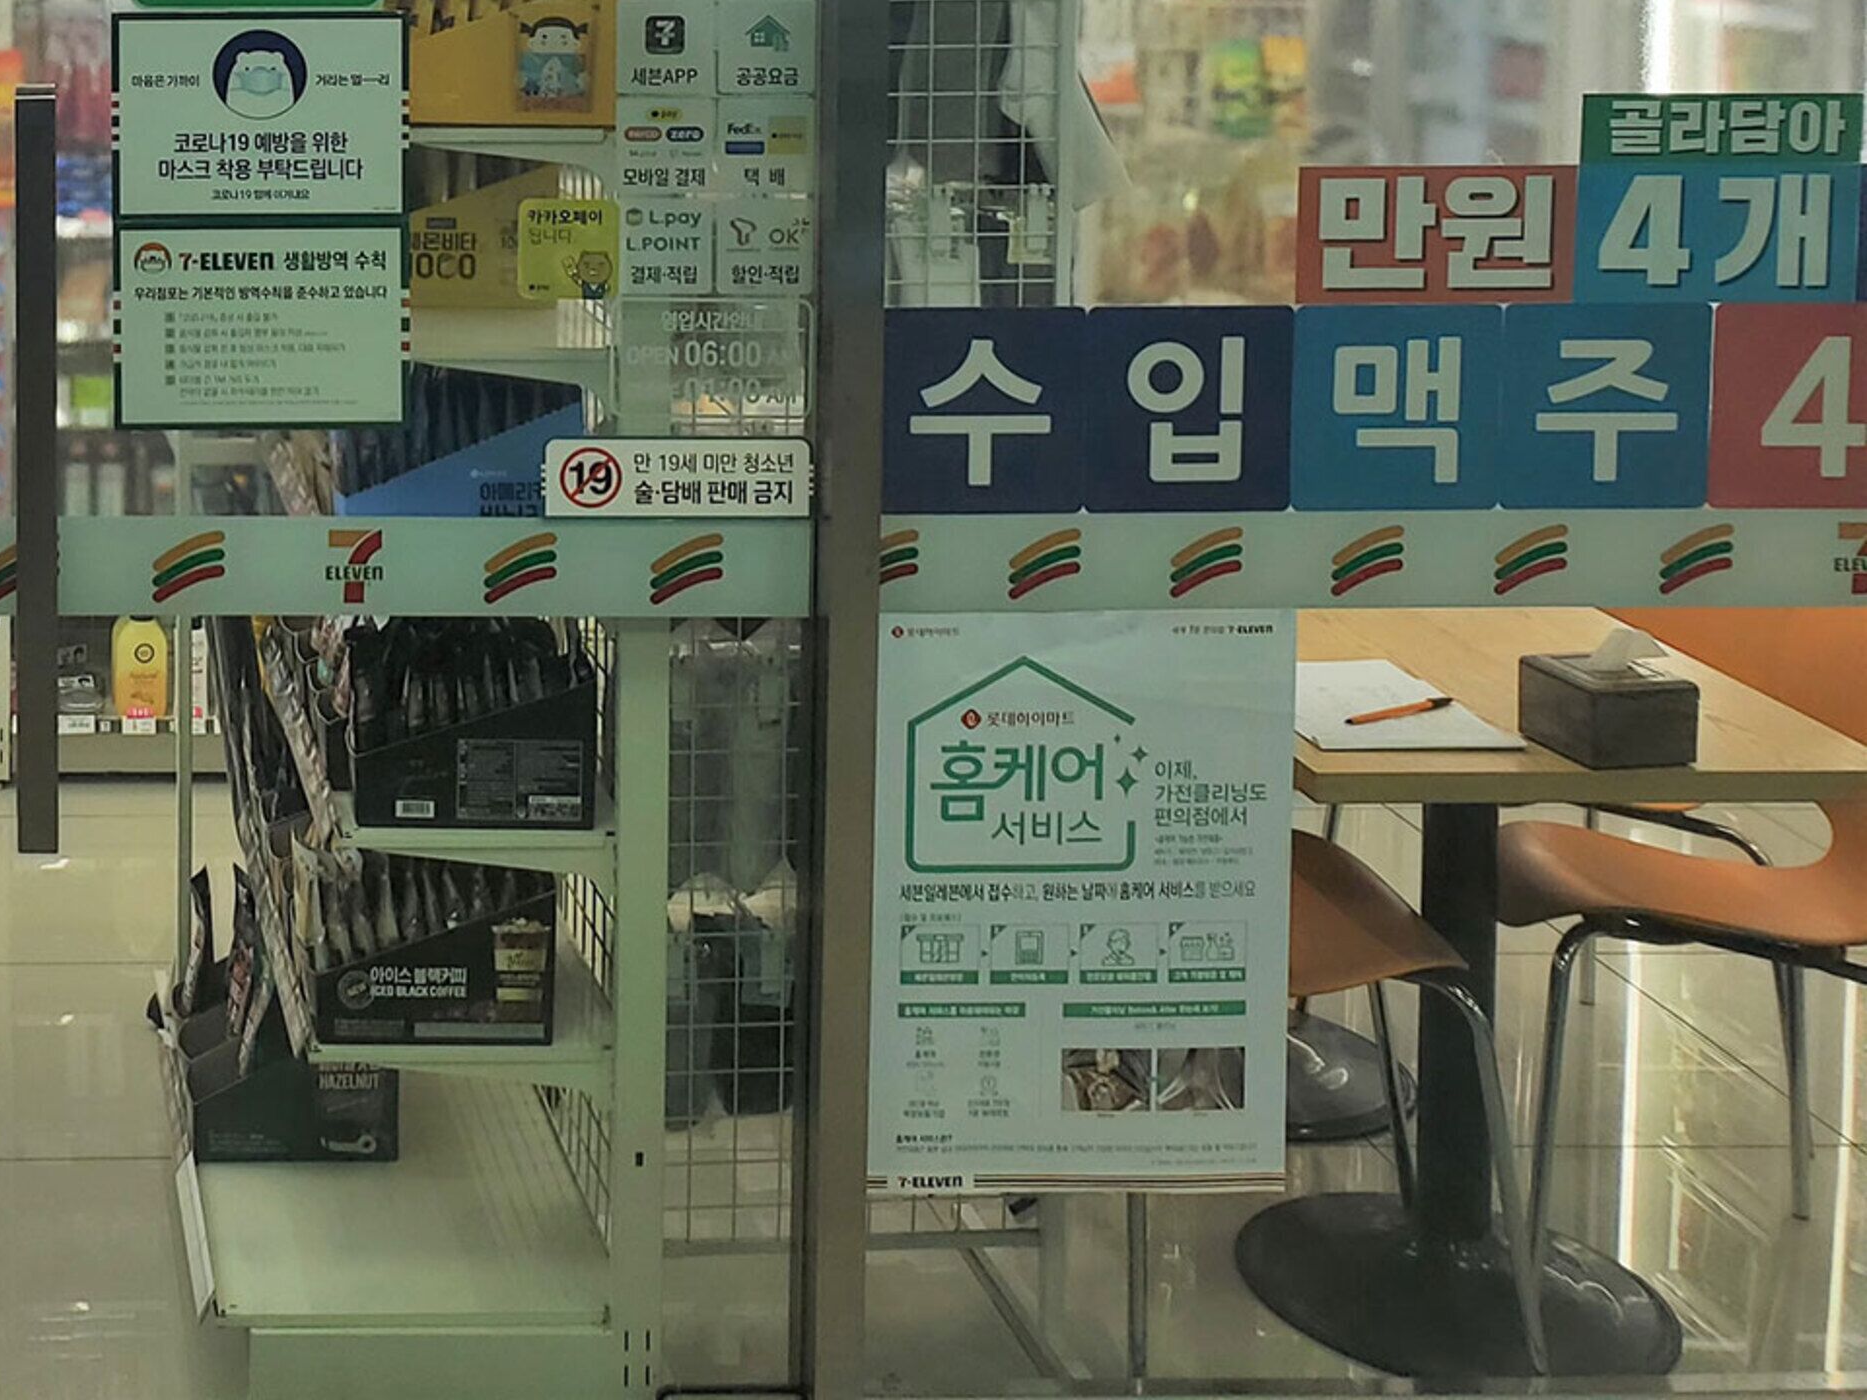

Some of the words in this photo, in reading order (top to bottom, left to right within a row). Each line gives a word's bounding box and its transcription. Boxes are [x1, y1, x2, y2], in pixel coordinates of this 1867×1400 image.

[631, 67, 699, 87] 세븐APP
[736, 66, 800, 87] 공공요금
[1608, 99, 1847, 156] 골라담아
[174, 132, 250, 154] 코로나19
[254, 131, 307, 154] 예방을
[311, 131, 348, 154] 위한
[158, 158, 212, 181] 마스크
[216, 158, 252, 180] 착용
[256, 157, 364, 181] 부탁드립니다
[622, 167, 670, 187] 모바일
[675, 167, 706, 187] 결제
[527, 209, 603, 225] 카카오페이
[649, 210, 702, 228] L.pay
[625, 236, 702, 251] L.POINT
[1318, 174, 1555, 292] 만원
[283, 250, 349, 272] 생활방역
[354, 250, 388, 272] 수칙
[684, 340, 761, 367] 06:00
[633, 453, 652, 473] 만
[659, 453, 697, 472] 19세
[702, 453, 738, 472] 미만
[742, 452, 794, 472] 청소년
[707, 480, 748, 504] 판매
[754, 480, 794, 504] 금지
[930, 740, 1104, 821] 홈케어
[1154, 760, 1198, 781] 이제,
[1154, 783, 1268, 804] 가전클리닝도
[1154, 806, 1249, 827] 편의점에서
[991, 811, 1103, 846] 서비스
[899, 883, 985, 901] 세븐일레븐에서
[1042, 882, 1079, 901] 원하는
[1119, 881, 1155, 900] 홈케어
[369, 966, 412, 984] 아이스
[413, 966, 468, 984] 블랙커피
[396, 985, 429, 998] BLACK
[430, 985, 468, 998] COFFEE
[318, 1072, 380, 1090] HAZELNUT
